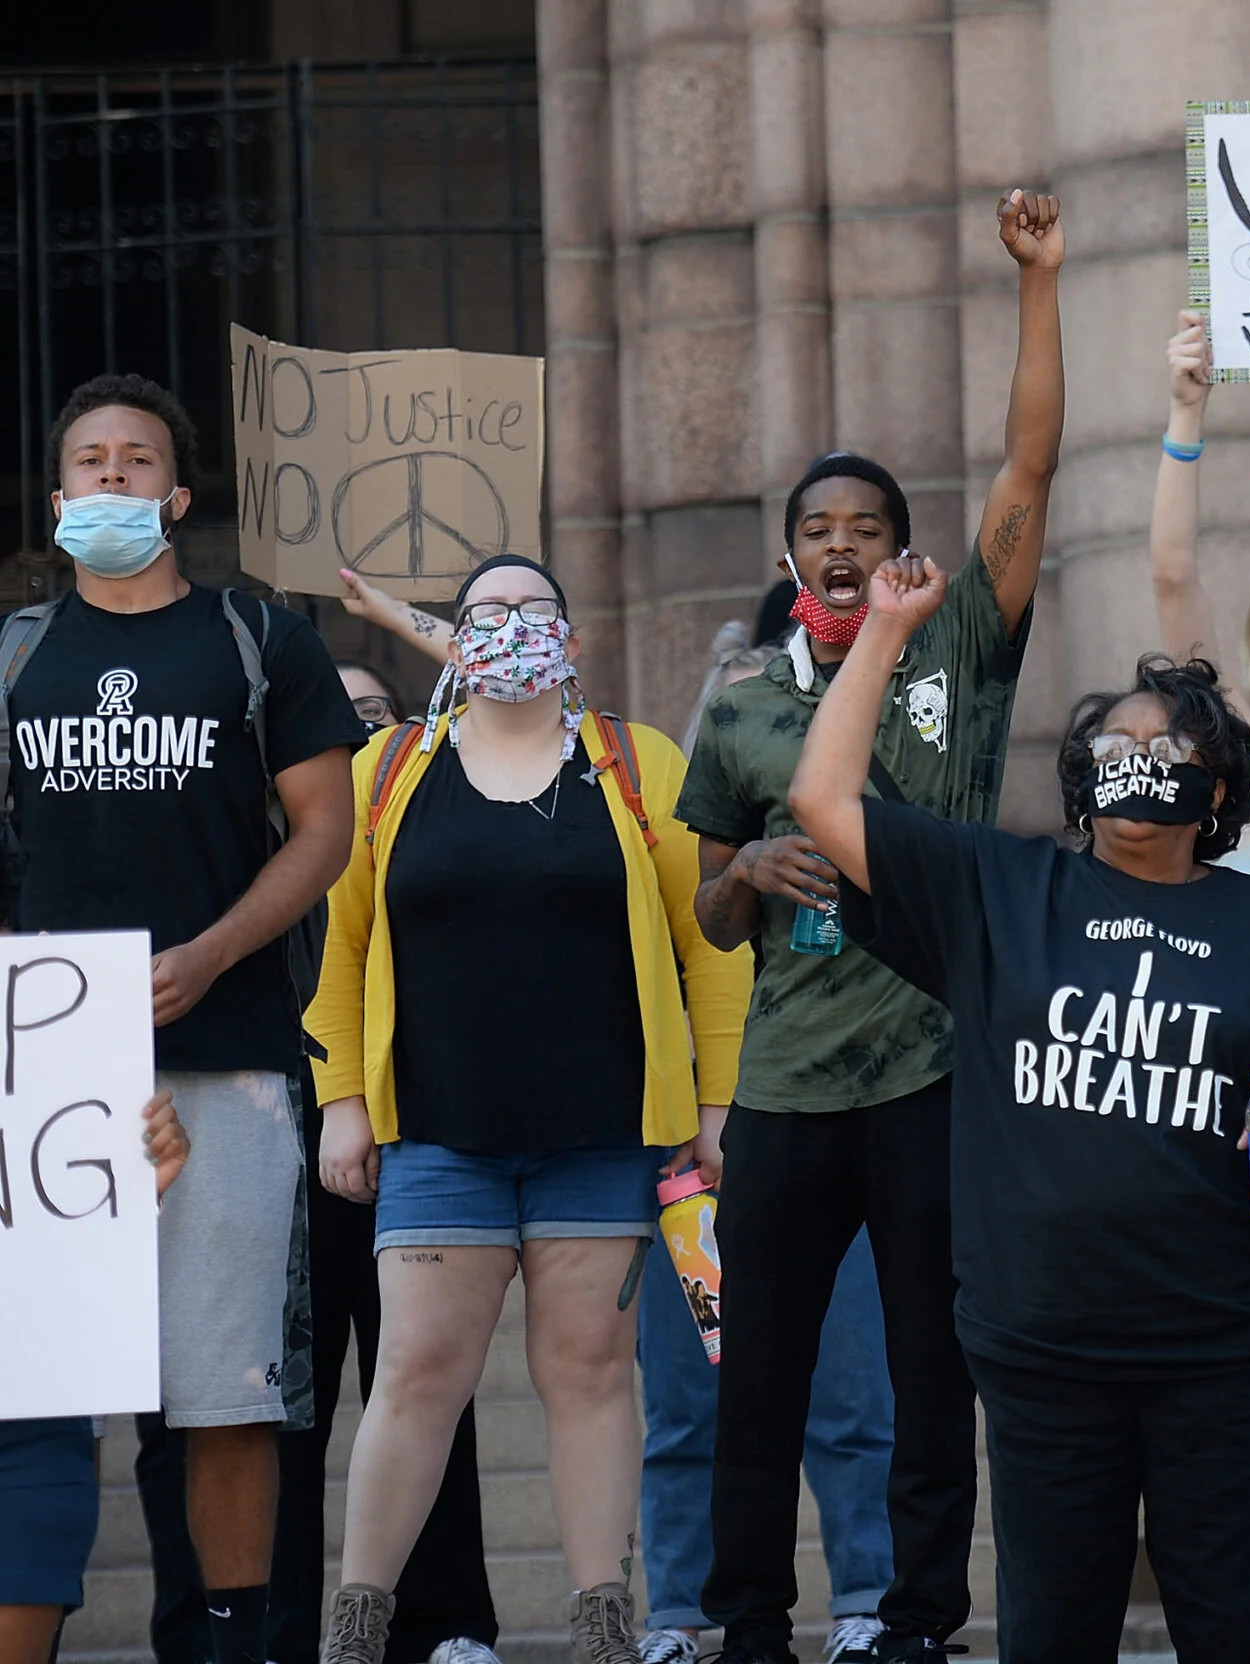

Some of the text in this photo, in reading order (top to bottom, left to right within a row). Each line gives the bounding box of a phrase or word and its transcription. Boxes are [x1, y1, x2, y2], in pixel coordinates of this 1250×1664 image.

[241, 344, 526, 451] NO Justice
[240, 457, 320, 545] NO
[16, 716, 220, 770] OVERCOME
[41, 768, 190, 793] ADVERSITY
[1094, 774, 1180, 809] BREATHE
[1097, 754, 1172, 783] I CAN'T
[1085, 917, 1212, 958] GEORGE FLOYD
[1131, 951, 1154, 998] I
[1047, 985, 1222, 1065] CAN'T
[1014, 1038, 1235, 1137] BREATHE
